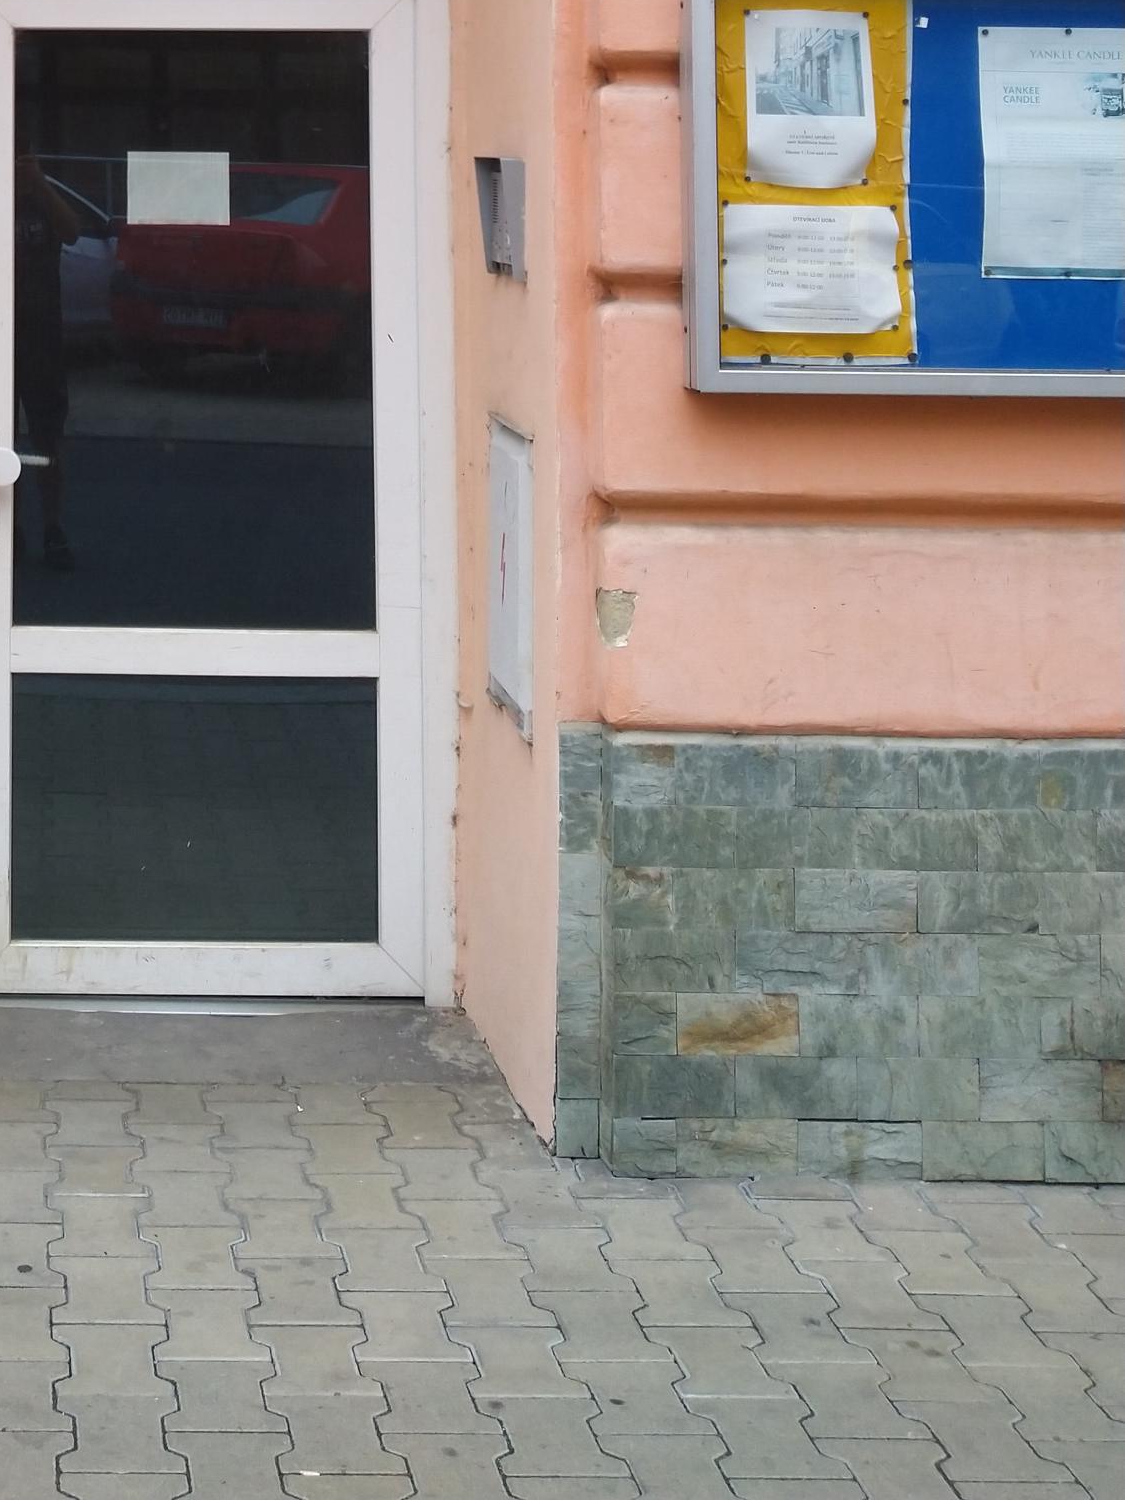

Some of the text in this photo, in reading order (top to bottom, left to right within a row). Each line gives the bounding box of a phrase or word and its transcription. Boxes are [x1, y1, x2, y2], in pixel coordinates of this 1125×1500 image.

[1077, 49, 1123, 61] CANDLE
[1003, 86, 1040, 95] YANKEE
[1003, 95, 1041, 104] CANDLE
